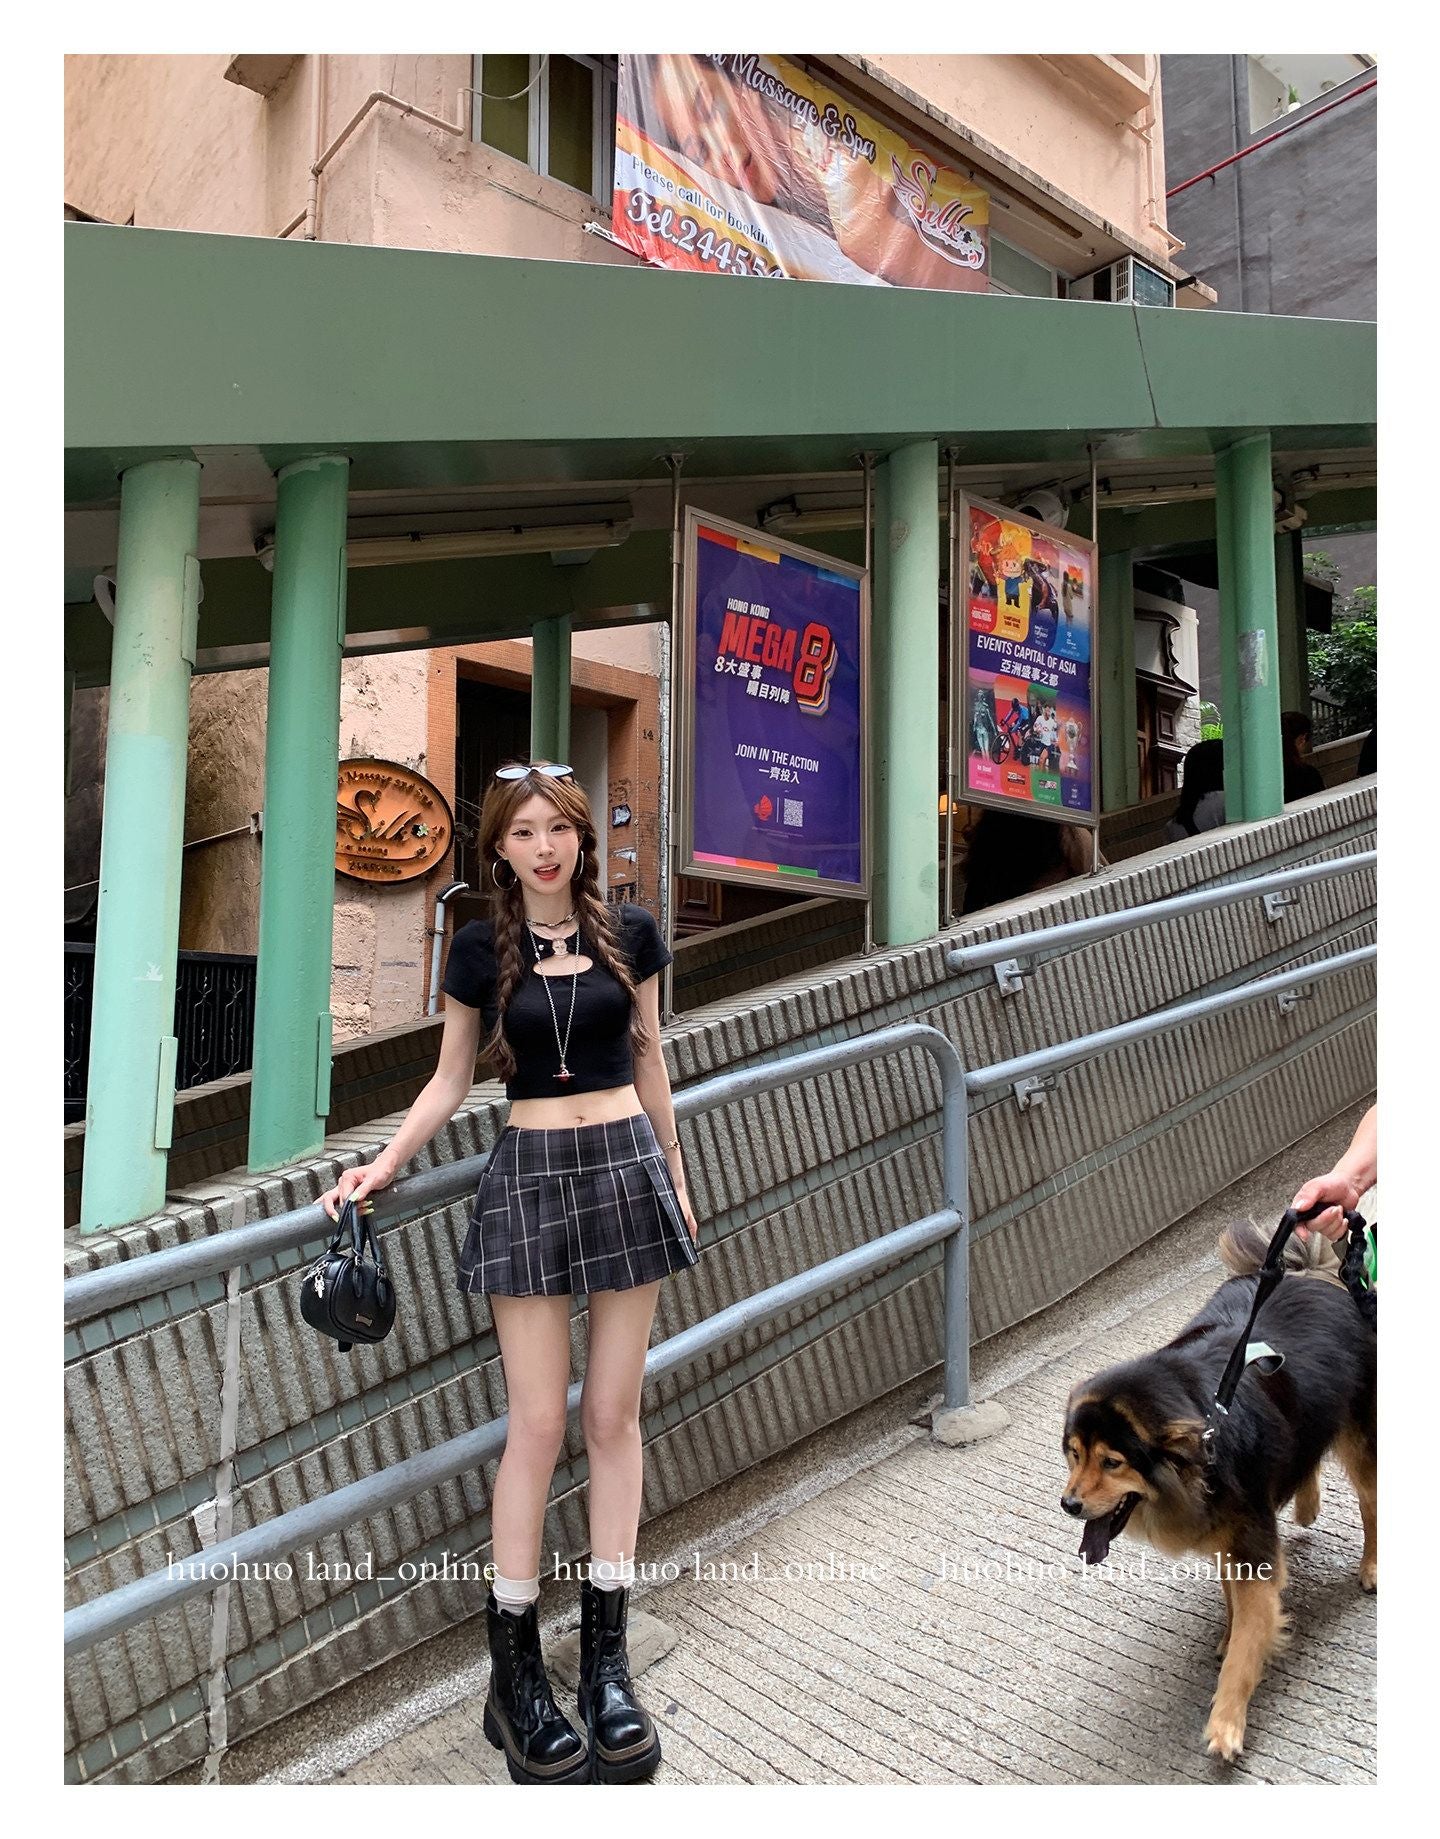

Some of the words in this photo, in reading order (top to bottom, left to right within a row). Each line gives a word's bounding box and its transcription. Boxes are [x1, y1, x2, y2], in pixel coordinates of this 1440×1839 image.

[731, 54, 819, 124] Massage
[821, 107, 841, 137] &
[842, 116, 876, 160] Spa
[632, 156, 674, 193] Please
[678, 187, 701, 207] call
[705, 199, 723, 220] for
[726, 598, 749, 614] HONG
[750, 603, 771, 620] KONG
[714, 656, 763, 680] 8大盛事
[718, 611, 798, 673] MEGA
[793, 622, 836, 706] 8
[977, 635, 1013, 655] EVENTS
[1014, 644, 1046, 666] CAPITAL
[1047, 655, 1058, 669] OF
[1058, 660, 1077, 676] ASIA
[1000, 658, 1059, 687] 亞洲盛事之都
[735, 743, 758, 759] JOIN
[758, 747, 770, 762] IN
[772, 750, 789, 766] THE
[789, 755, 819, 773] ACTION
[758, 766, 800, 784] 一齊投入
